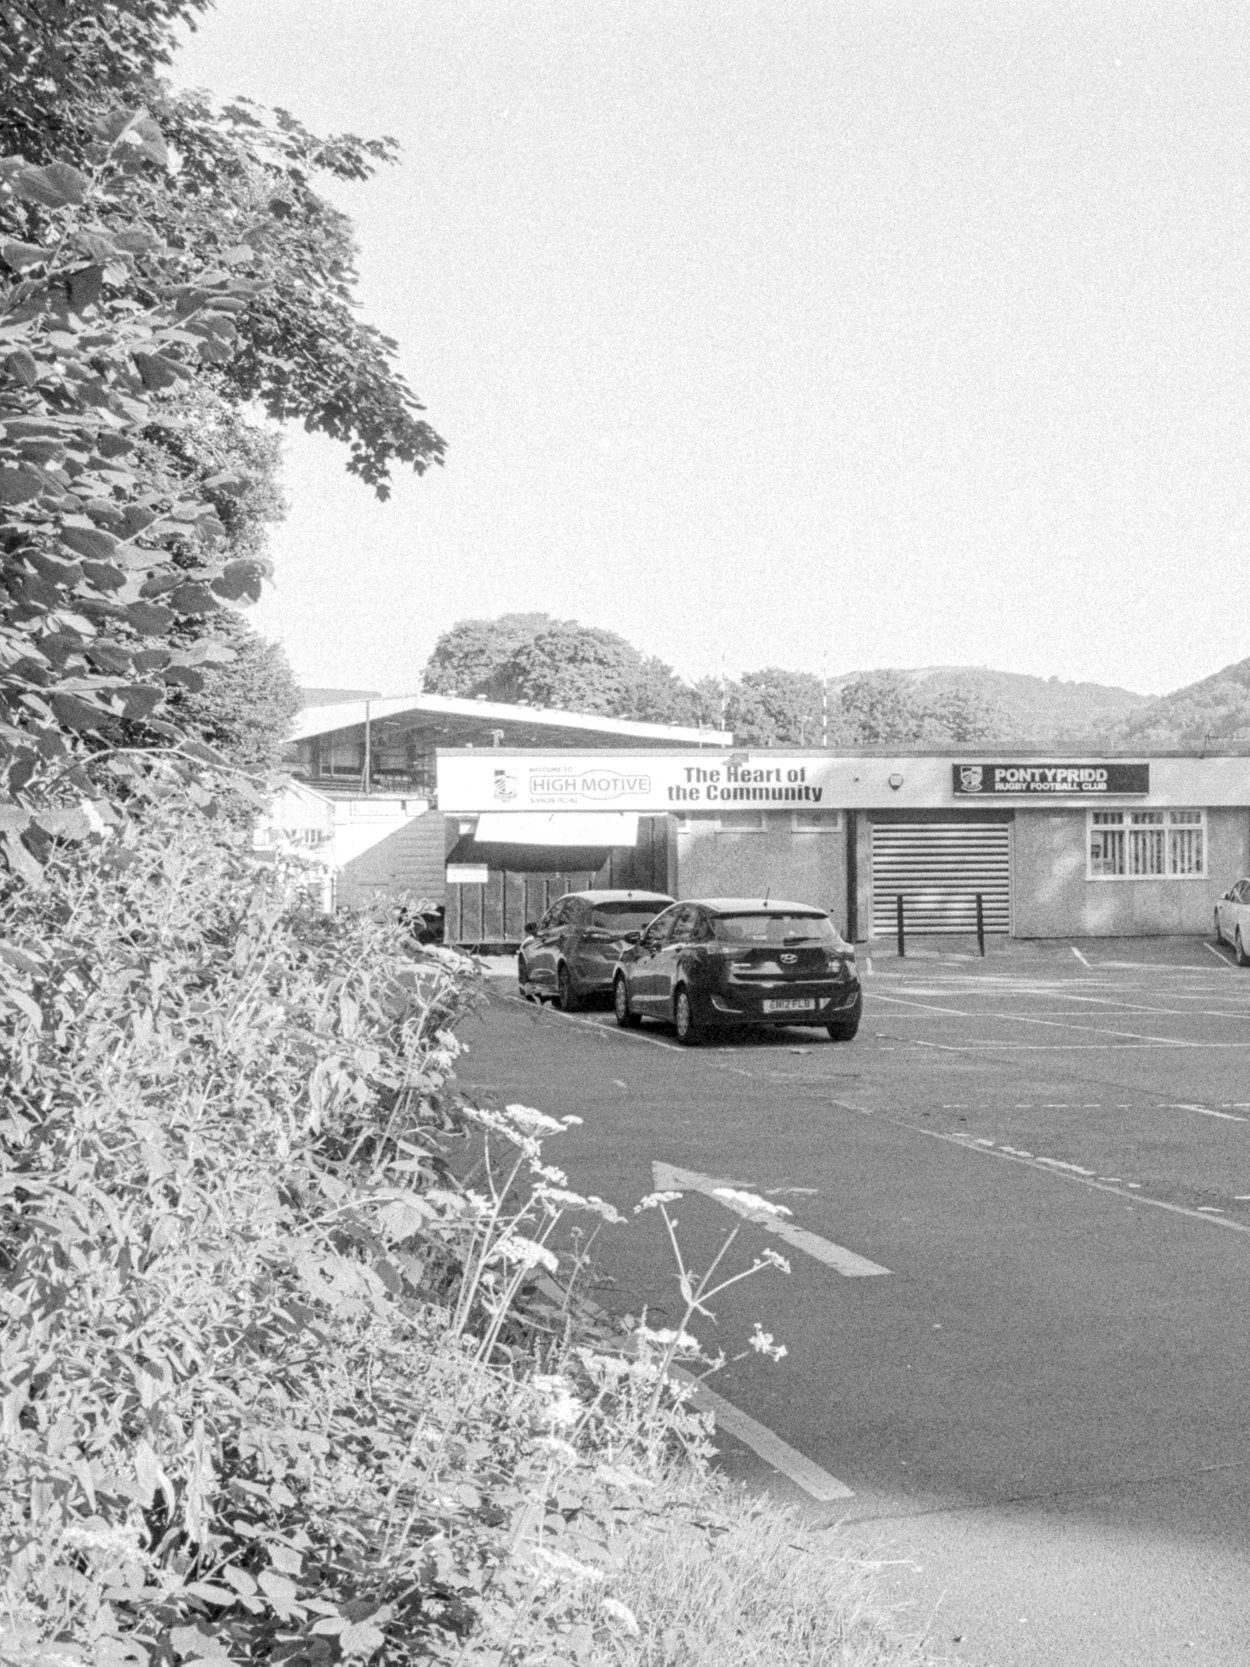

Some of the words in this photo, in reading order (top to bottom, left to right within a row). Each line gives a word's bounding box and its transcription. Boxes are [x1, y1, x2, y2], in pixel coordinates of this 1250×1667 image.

[684, 767, 721, 783] The
[726, 766, 782, 783] Heart
[787, 767, 806, 783] of
[994, 768, 1108, 782] PONTYPRIDD
[533, 778, 577, 792] HIGH
[581, 778, 648, 792] MOTIVE
[994, 782, 1027, 791] RUGBY
[1030, 782, 1080, 791] FOOTBALL
[1082, 782, 1108, 791] CLUB
[667, 785, 701, 801] the
[706, 784, 823, 802] Community
